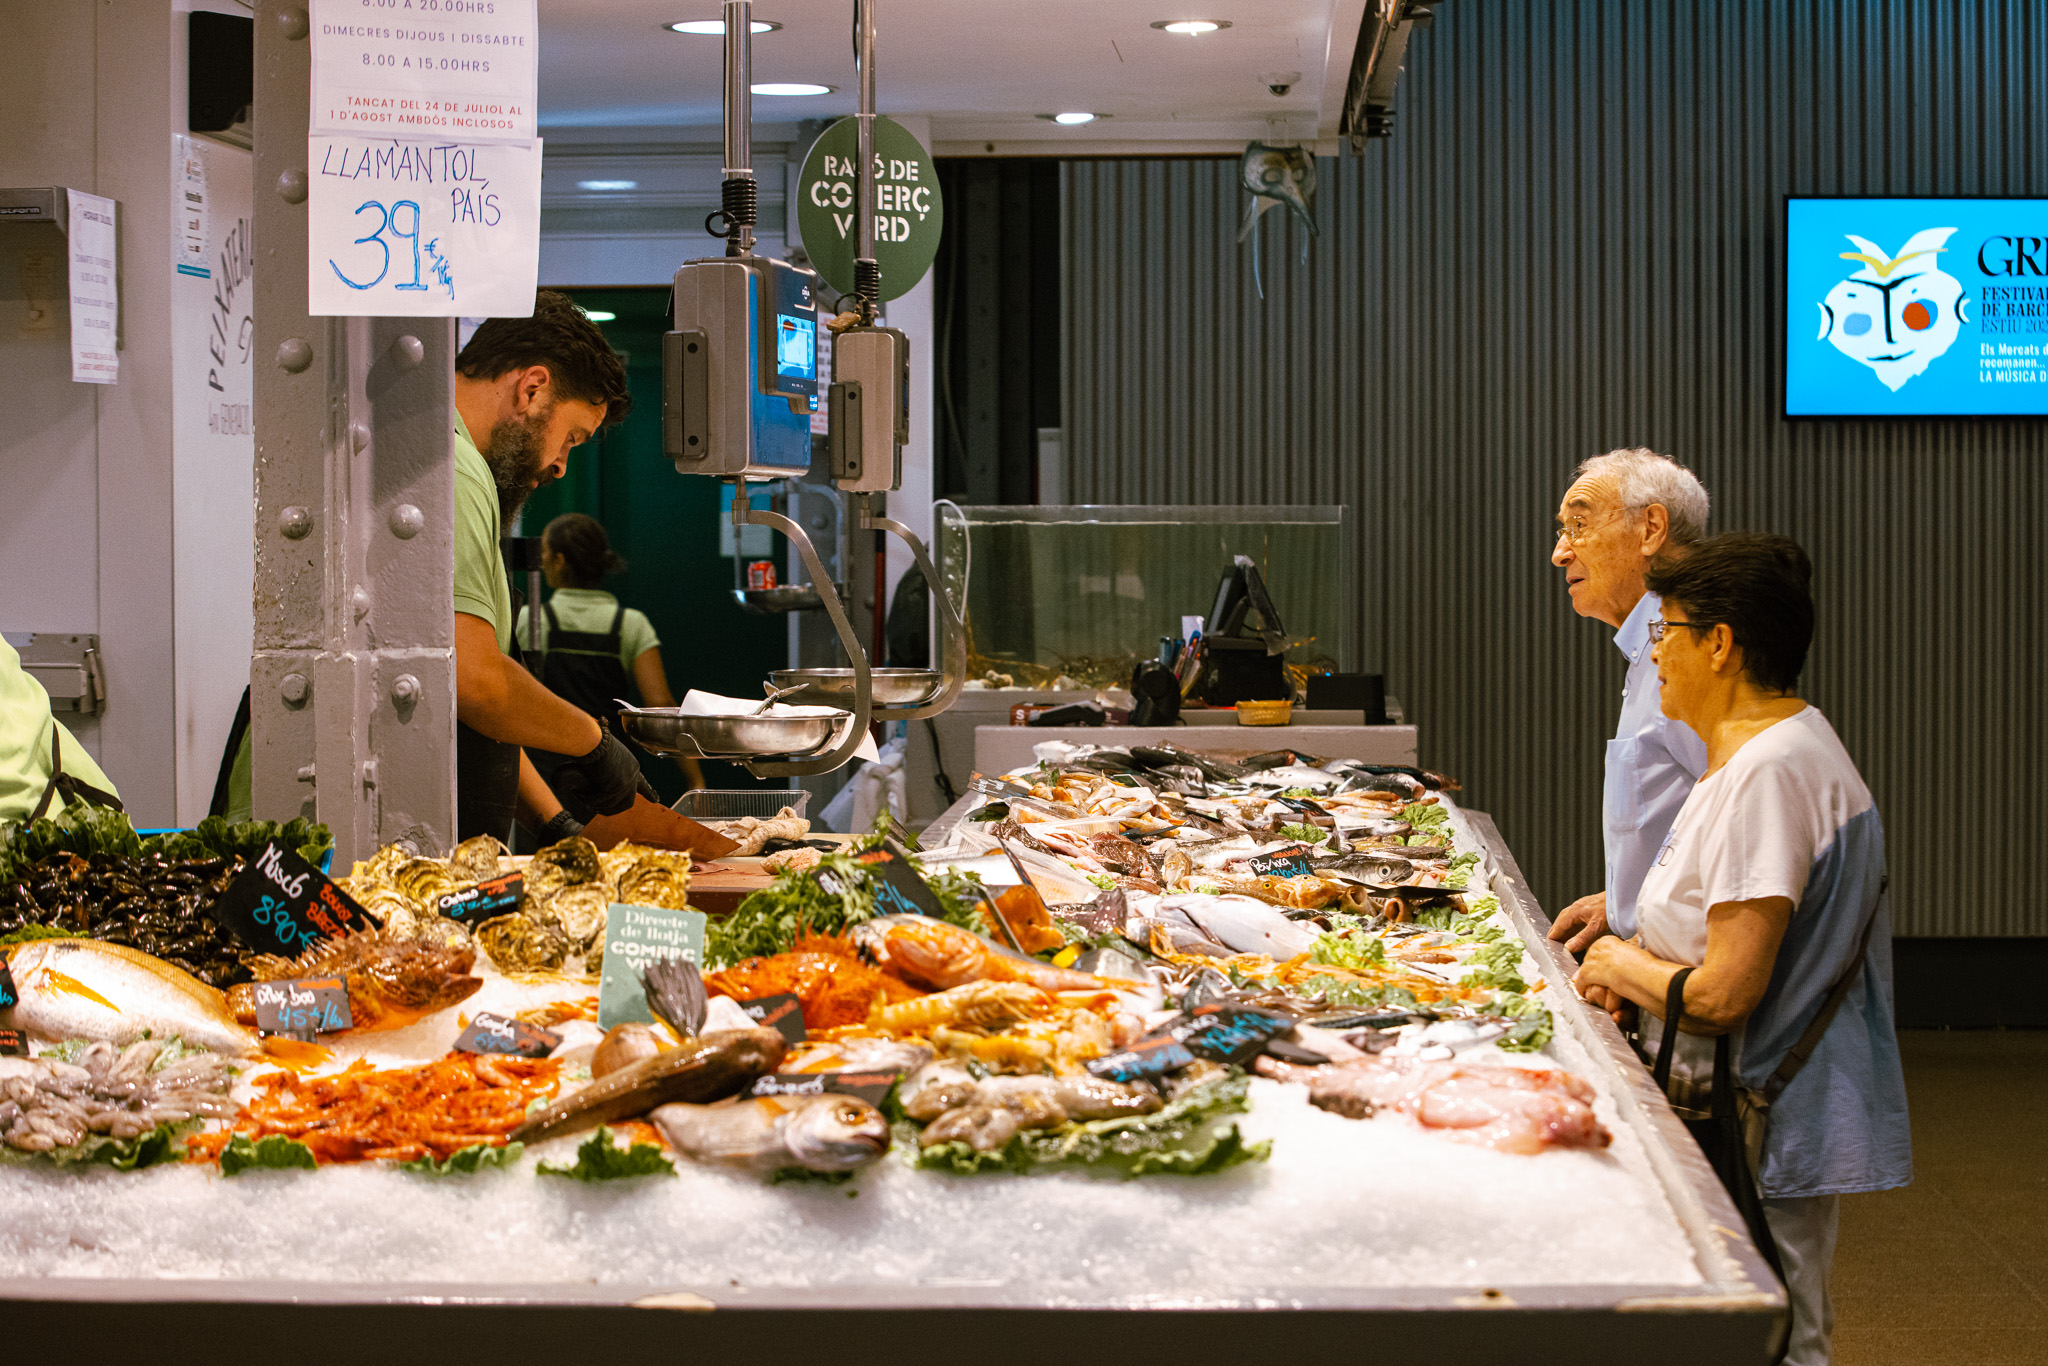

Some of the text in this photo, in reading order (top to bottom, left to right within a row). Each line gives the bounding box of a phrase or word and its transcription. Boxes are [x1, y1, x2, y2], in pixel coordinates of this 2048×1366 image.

[420, 0, 494, 14] 20.00HRS
[323, 24, 525, 46] DIMECRES DIJOUS I DISSABTE
[362, 53, 490, 72] 8.00 A 15.00HRS
[348, 96, 522, 116] TANCAT DEL 24 DE JULIOL AL
[339, 110, 393, 122] D'AGOST
[398, 114, 447, 126] AMBDÓS
[452, 117, 514, 129] INCLOSOS
[824, 153, 919, 181] RAÓ DE
[810, 180, 931, 221] COERÇ
[832, 212, 910, 242] VRD
[1978, 235, 2048, 277] GR
[1982, 286, 2048, 301] FESTIVA
[1982, 303, 2048, 317] DE BARC
[1982, 319, 2021, 333] ESTIU
[1980, 342, 1995, 356] Els
[1999, 342, 2040, 356] Mercats
[1980, 370, 1993, 383] LA
[620, 925, 641, 938] de
